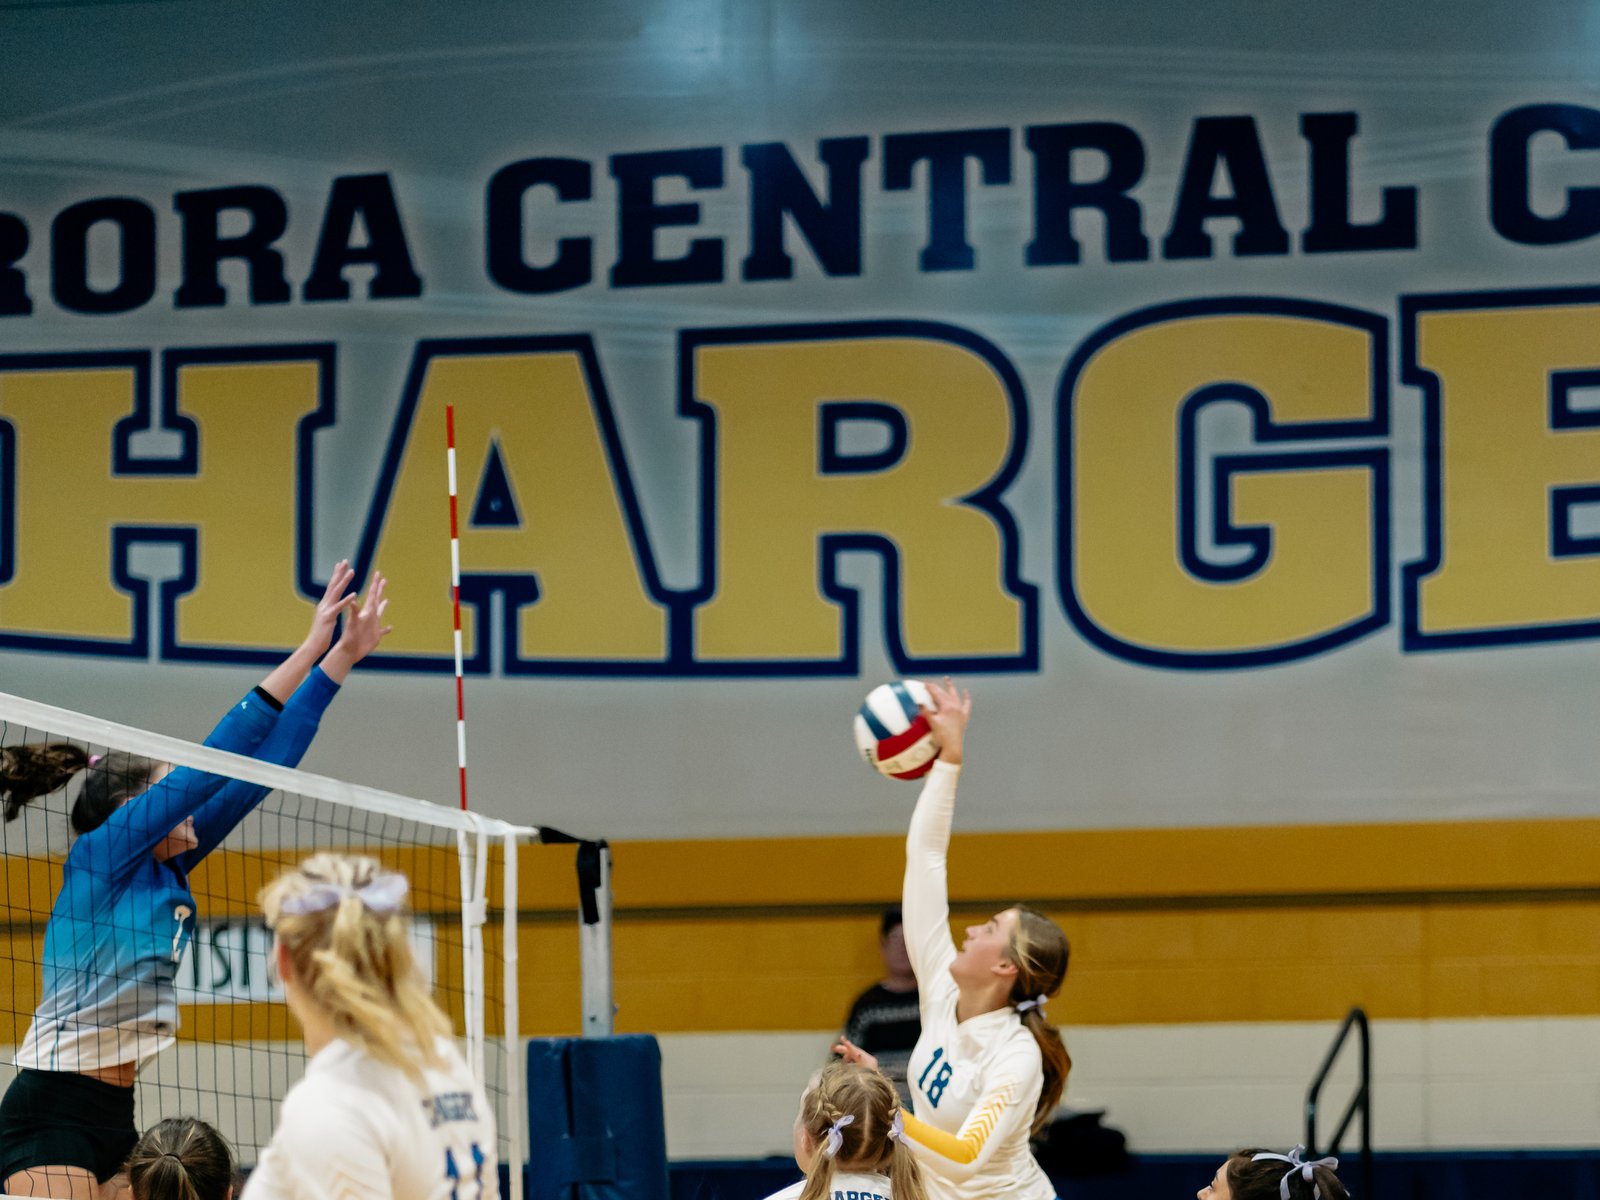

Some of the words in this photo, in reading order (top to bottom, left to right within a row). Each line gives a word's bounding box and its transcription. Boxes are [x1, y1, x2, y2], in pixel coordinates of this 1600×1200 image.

[0, 172, 423, 316] ORA
[486, 110, 1418, 294] CENTRAL
[1489, 103, 1600, 246] C
[0, 284, 1600, 677] HARGE
[918, 1047, 952, 1109] 18
